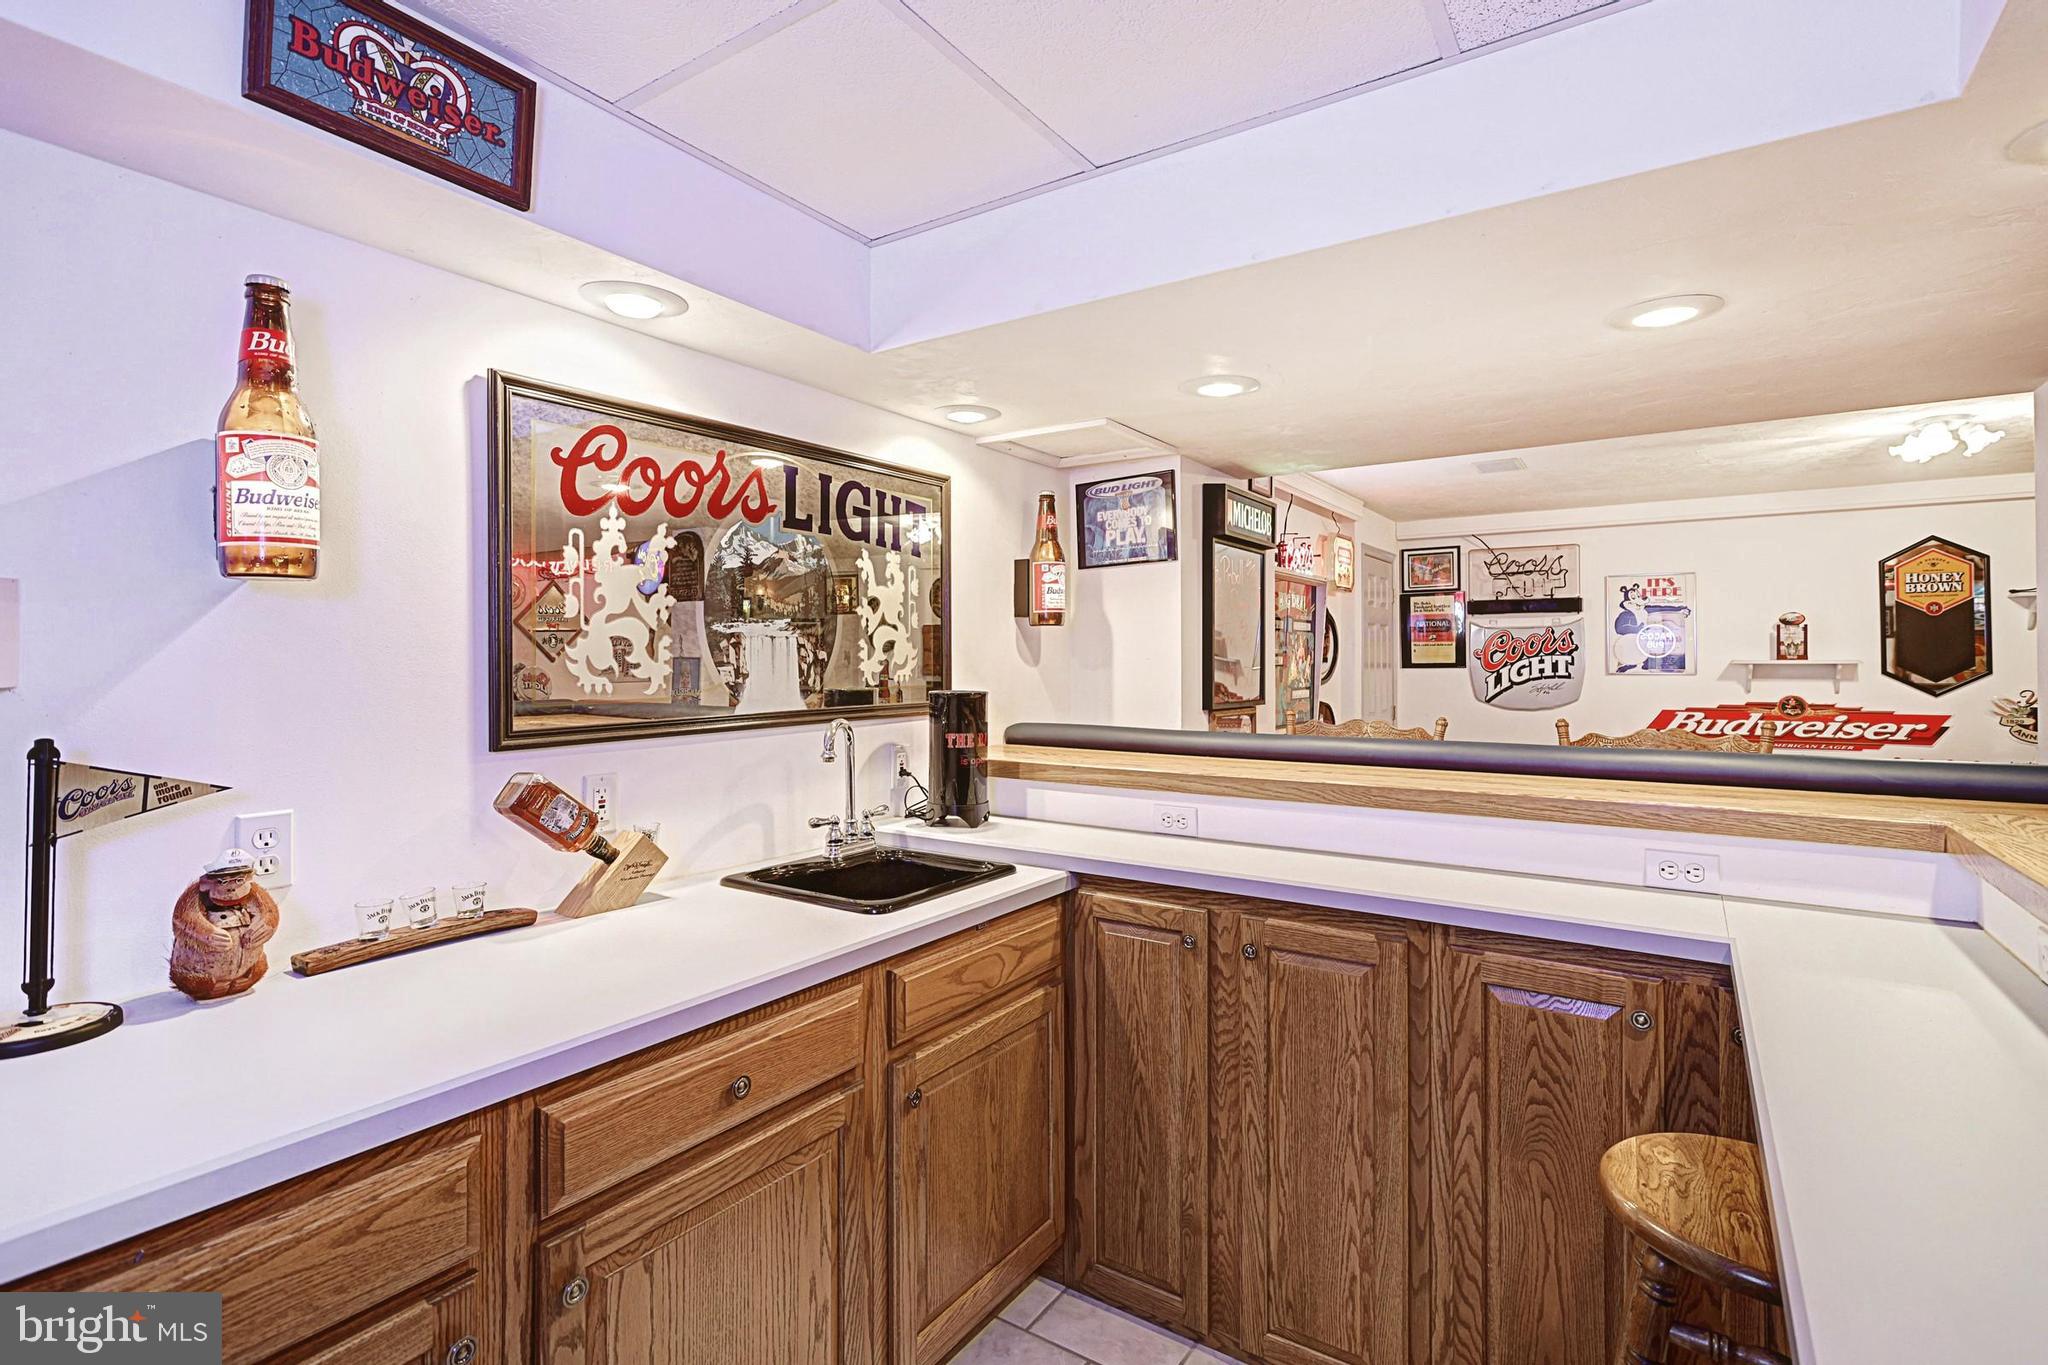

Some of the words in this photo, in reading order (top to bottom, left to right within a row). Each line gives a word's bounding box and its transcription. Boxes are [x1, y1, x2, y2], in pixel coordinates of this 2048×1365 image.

[366, 103, 392, 119] KING
[393, 114, 406, 126] OF
[406, 120, 437, 140] BEERS
[550, 424, 778, 524] Coors
[782, 464, 927, 558] LIGHT
[1094, 485, 1120, 495] BUD
[1121, 480, 1158, 492] LIGHT
[1232, 500, 1272, 536] MICHELOB
[1483, 552, 1569, 577] Coors
[1647, 577, 1676, 588] IT'S
[1904, 572, 1965, 584] HONEY
[1641, 587, 1682, 597] HERE
[1904, 581, 1964, 594] BROWN
[1416, 620, 1451, 628] NATIONAL
[1473, 626, 1579, 672] Coors
[1485, 655, 1574, 703] LIGHT
[1658, 710, 1929, 742] Budweiser
[945, 732, 975, 749] THE
[153, 781, 169, 790] one
[155, 783, 181, 797] more
[58, 776, 137, 821] Coors
[157, 786, 193, 804] round!
